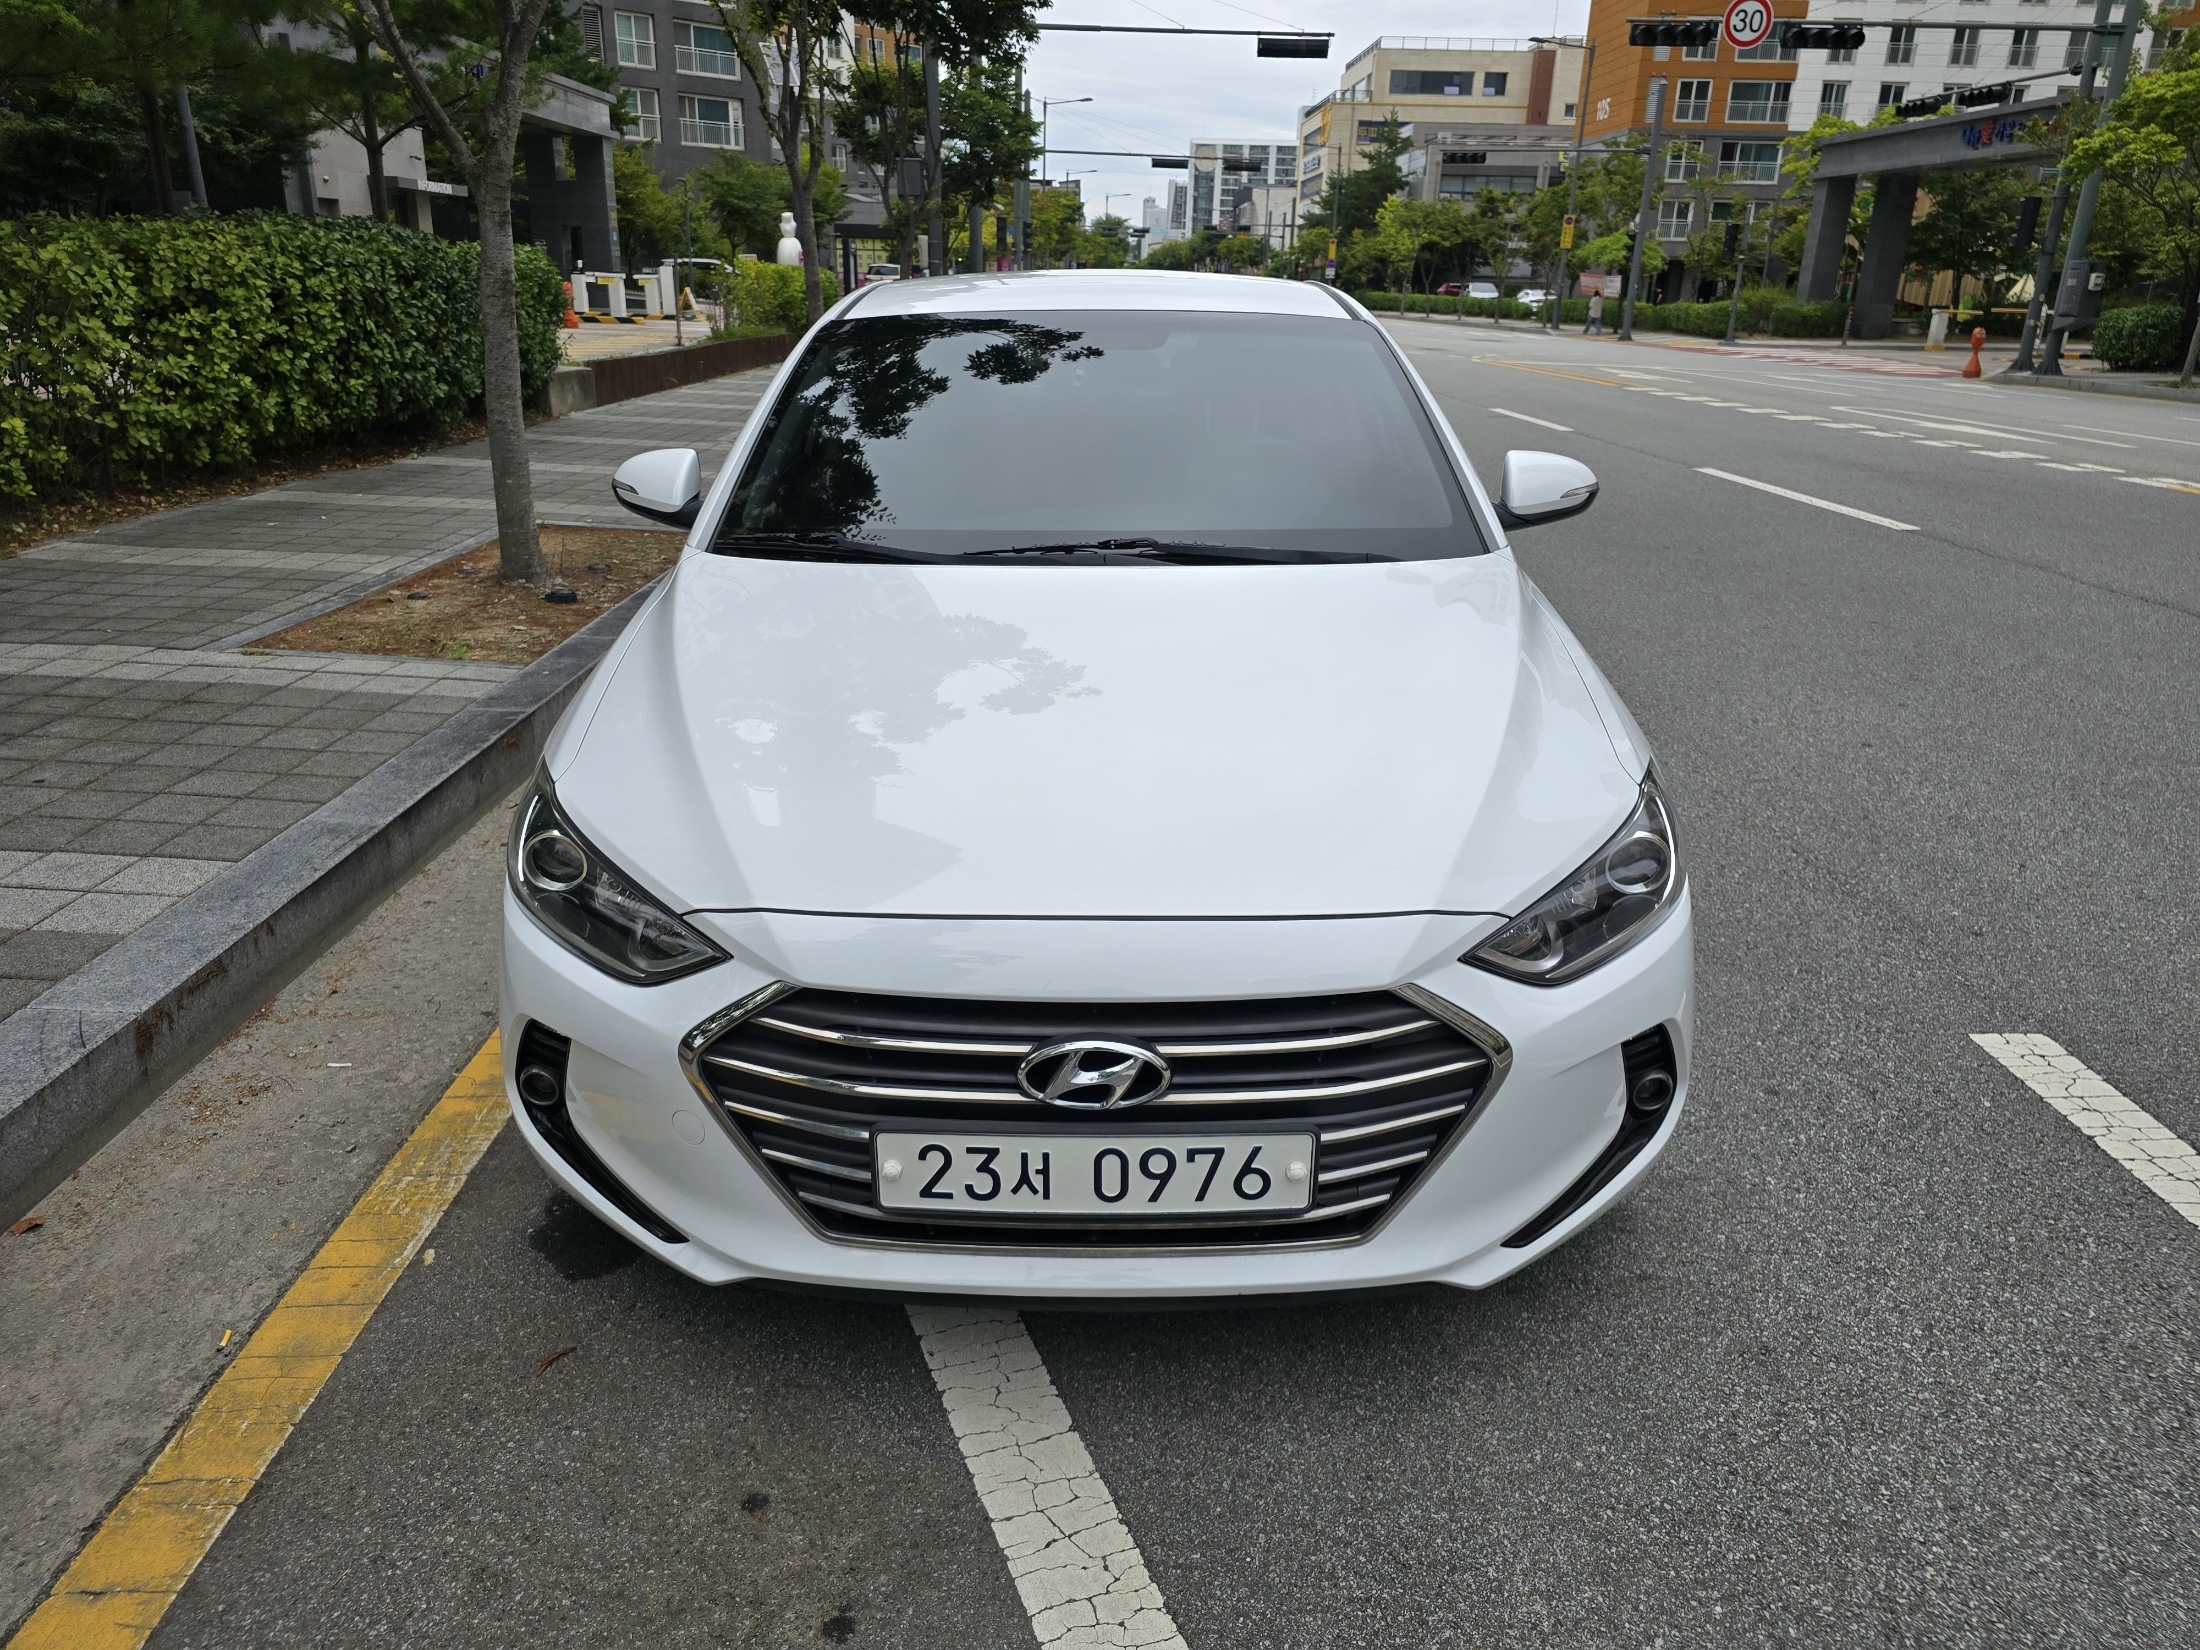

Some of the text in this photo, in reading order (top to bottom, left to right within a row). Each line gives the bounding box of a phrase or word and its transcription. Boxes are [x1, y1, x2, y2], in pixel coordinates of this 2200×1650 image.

[1733, 9, 1764, 33] 30
[417, 179, 453, 195] INFORMATION
[917, 1143, 1272, 1203] 23서 0976
